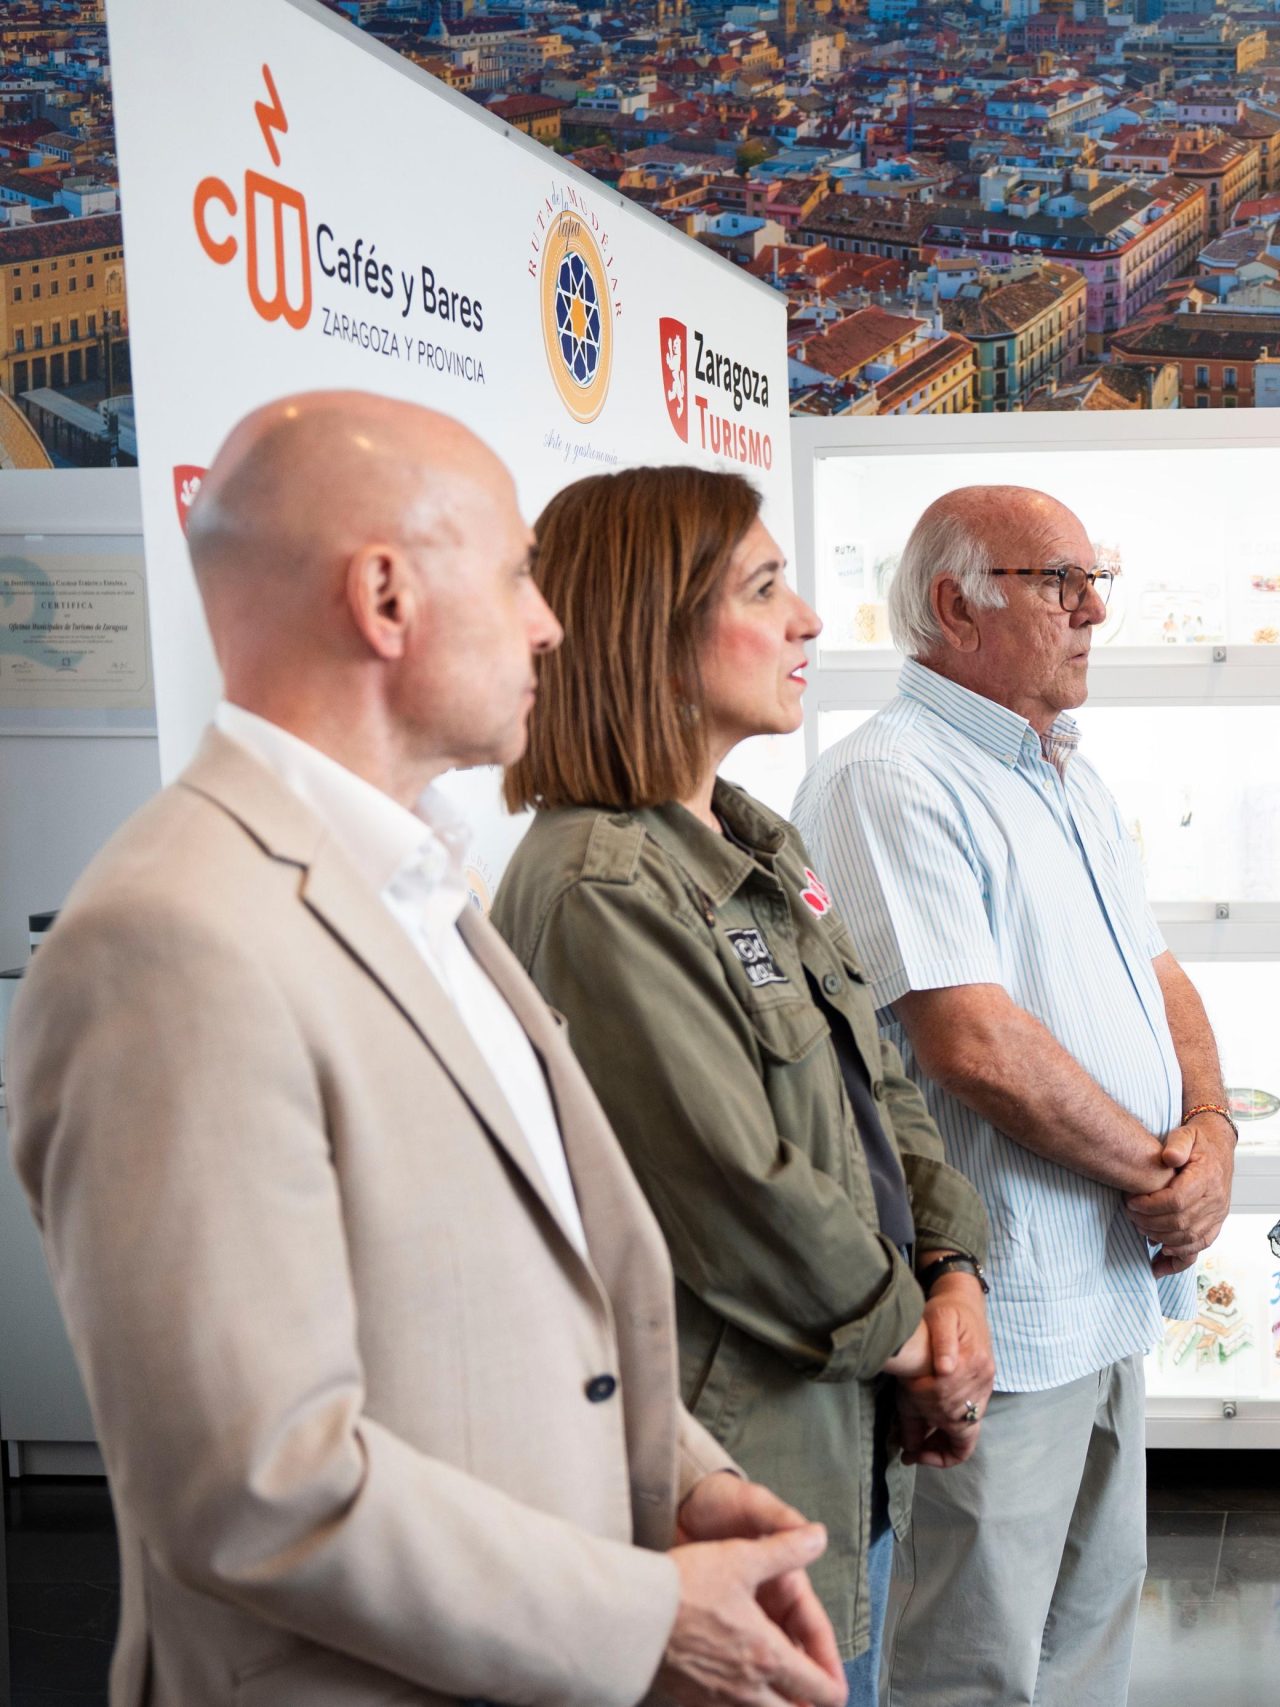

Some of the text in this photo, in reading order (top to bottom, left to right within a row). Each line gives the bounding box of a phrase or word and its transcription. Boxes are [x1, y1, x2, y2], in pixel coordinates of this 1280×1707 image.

[528, 198, 553, 278] RUTA
[316, 223, 484, 333] Cafés y Bares
[322, 306, 486, 384] ZARAGOZA Y PROVINCIA
[694, 330, 769, 412] Zaragoza
[695, 394, 772, 471] TURISMO
[41, 601, 94, 609] CERTIFICA
